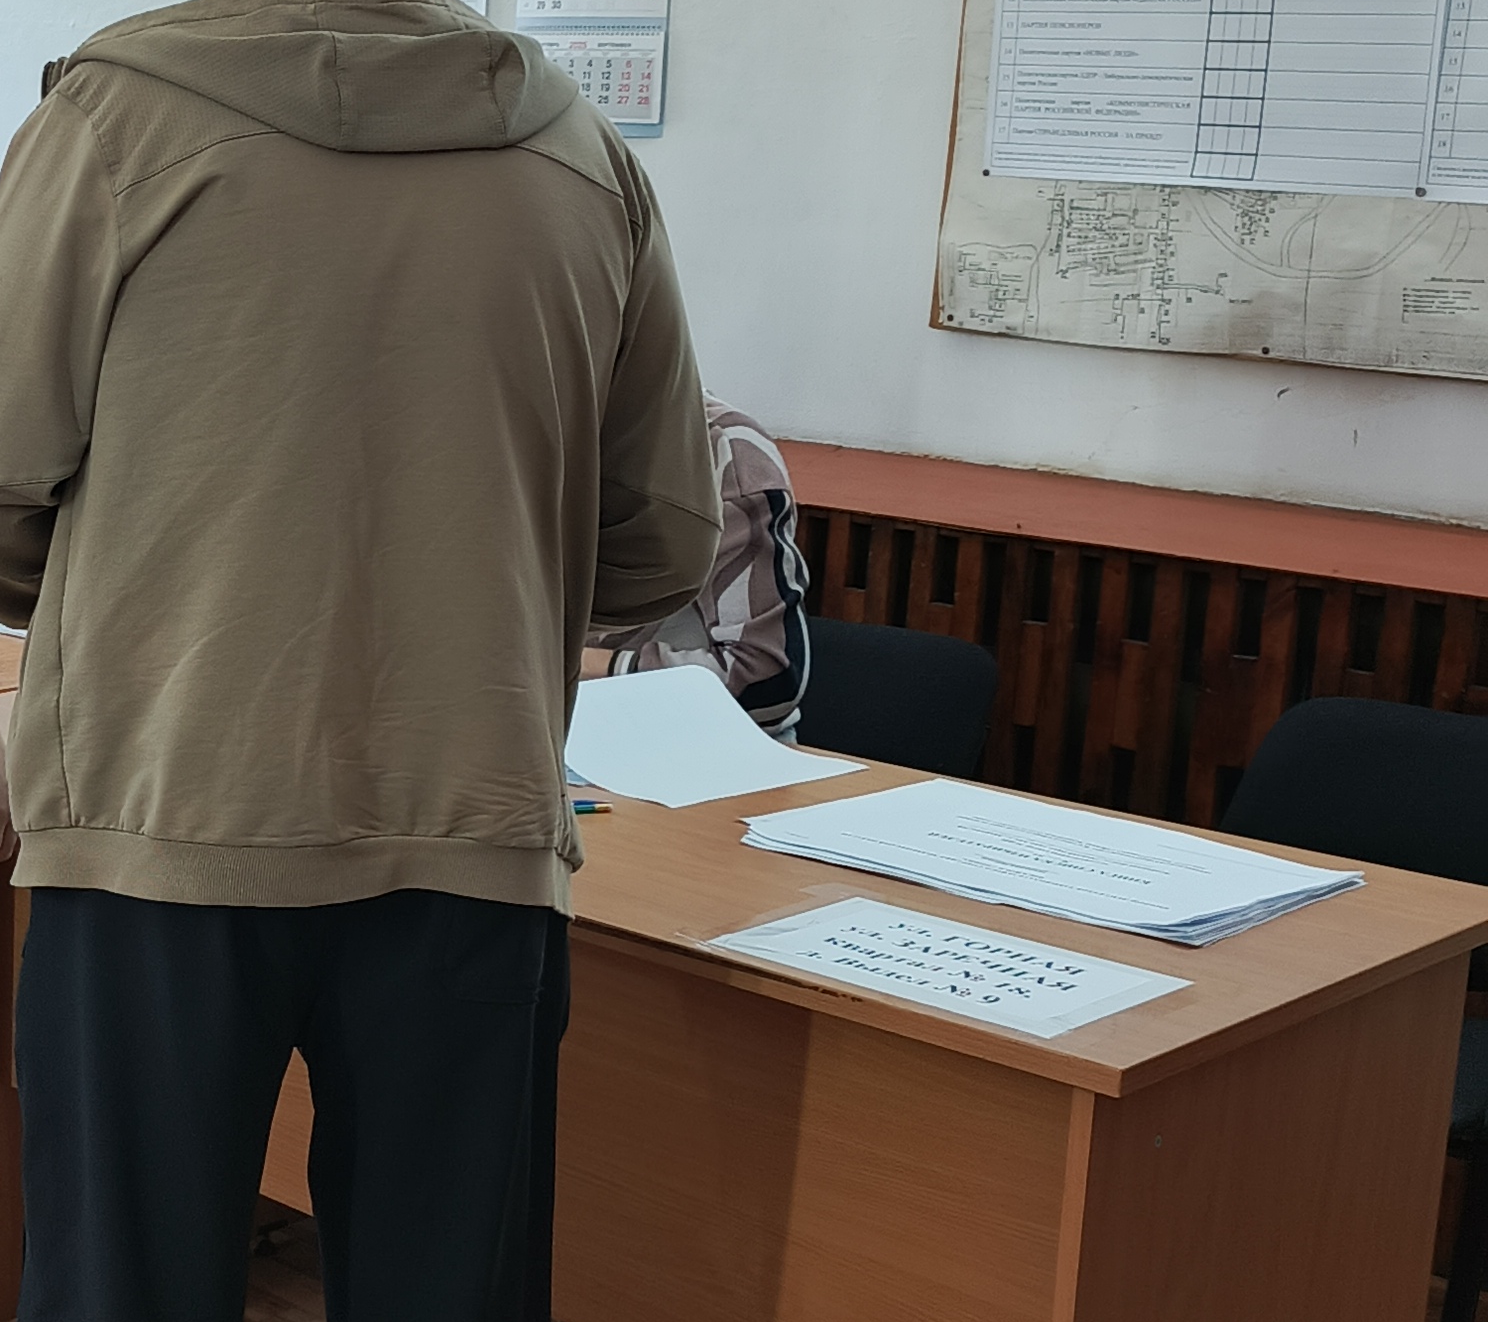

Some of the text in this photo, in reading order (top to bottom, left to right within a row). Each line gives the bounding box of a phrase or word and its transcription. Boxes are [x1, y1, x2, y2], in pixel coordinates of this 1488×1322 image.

[568, 59, 574, 68] 3
[586, 59, 593, 68] 4
[606, 59, 612, 68] 5
[646, 60, 653, 68] 7
[601, 71, 611, 80] 12
[641, 72, 651, 80] 14
[600, 84, 610, 92] 19
[618, 84, 630, 92] 20
[638, 84, 649, 93] 21
[617, 96, 629, 104] 27
[942, 935, 1088, 976] ГОРНАЯ
[891, 939, 1079, 991] ЗАРЕЧНАЯ
